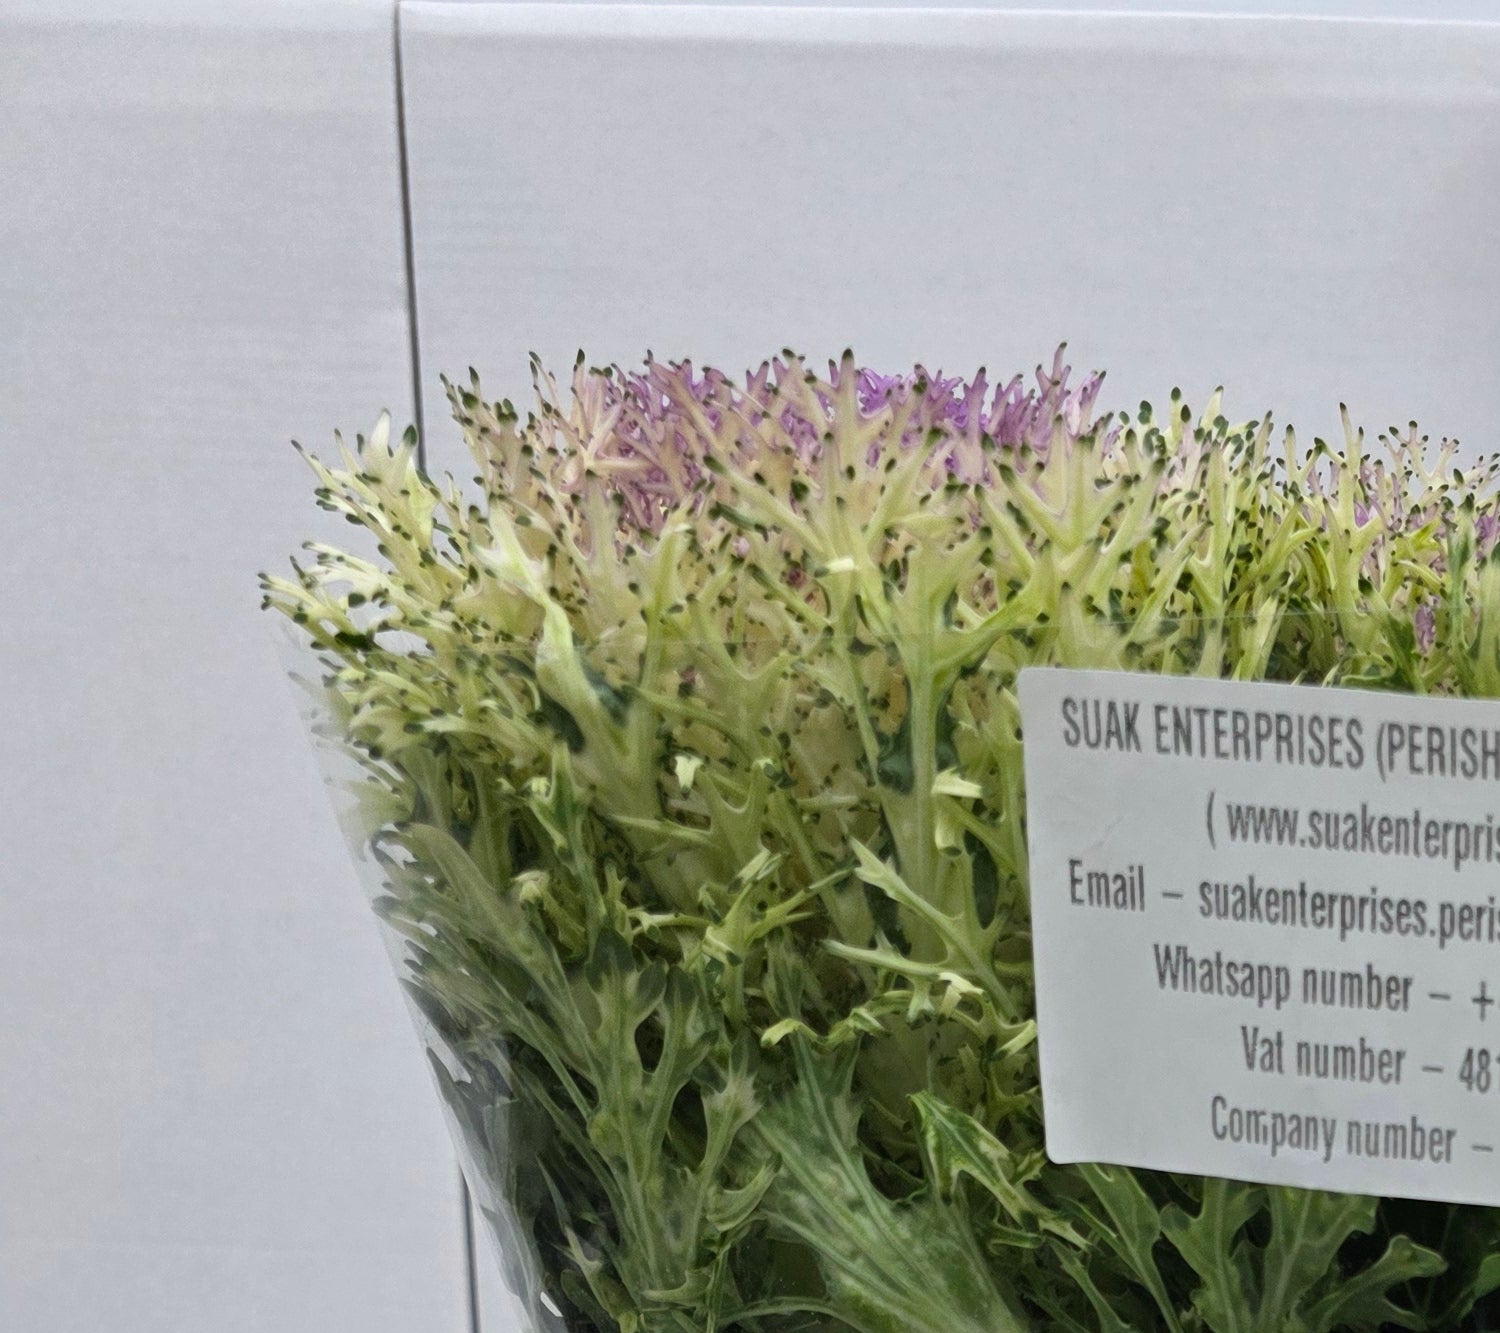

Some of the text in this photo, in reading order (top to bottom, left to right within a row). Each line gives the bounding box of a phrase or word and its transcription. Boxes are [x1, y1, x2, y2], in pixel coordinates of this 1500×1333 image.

[1062, 698, 1143, 754] SUAK
[1155, 704, 1365, 771] ENTERPRISES
[1069, 860, 1145, 913] Email
[1153, 944, 1291, 1013] Whatsapp
[1302, 960, 1413, 1013] number
[1240, 1026, 1286, 1076] Vat
[1296, 1032, 1405, 1086] number
[1210, 1096, 1337, 1163] Company
[1347, 1111, 1455, 1163] number
